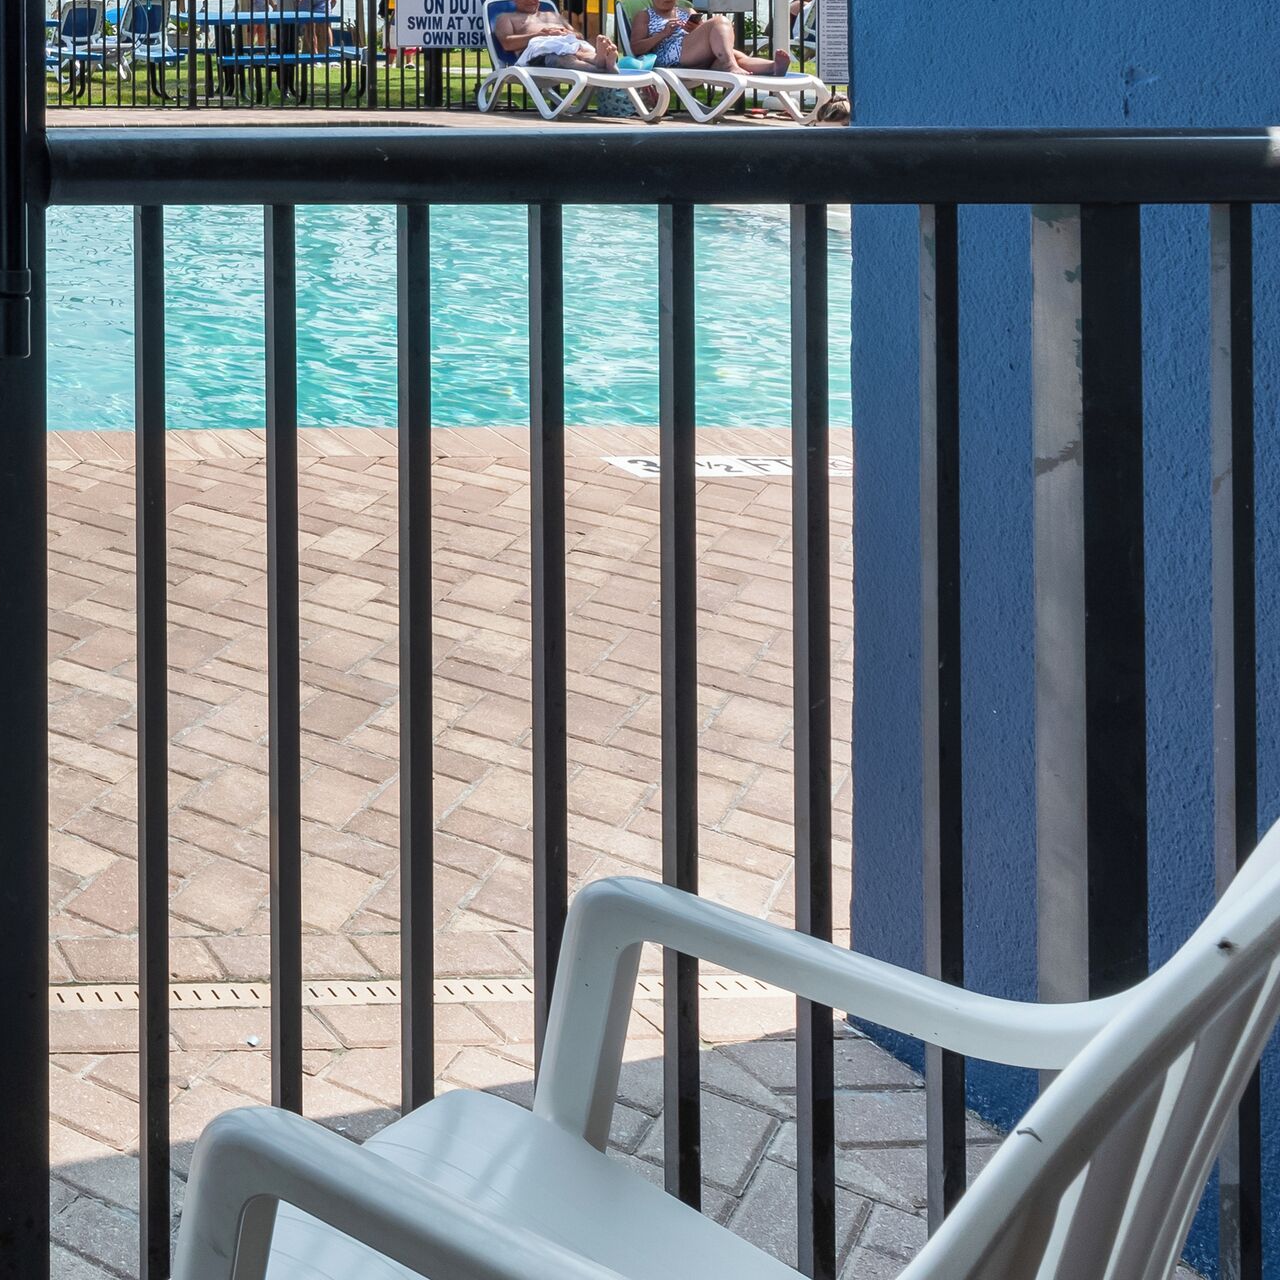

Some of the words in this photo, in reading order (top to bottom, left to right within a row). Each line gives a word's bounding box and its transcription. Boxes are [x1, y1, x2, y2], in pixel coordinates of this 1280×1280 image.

[407, 16, 443, 30] SWIM
[446, 16, 464, 30] AT
[467, 16, 485, 30] YO
[422, 31, 453, 45] OWN
[457, 31, 488, 45] RISK
